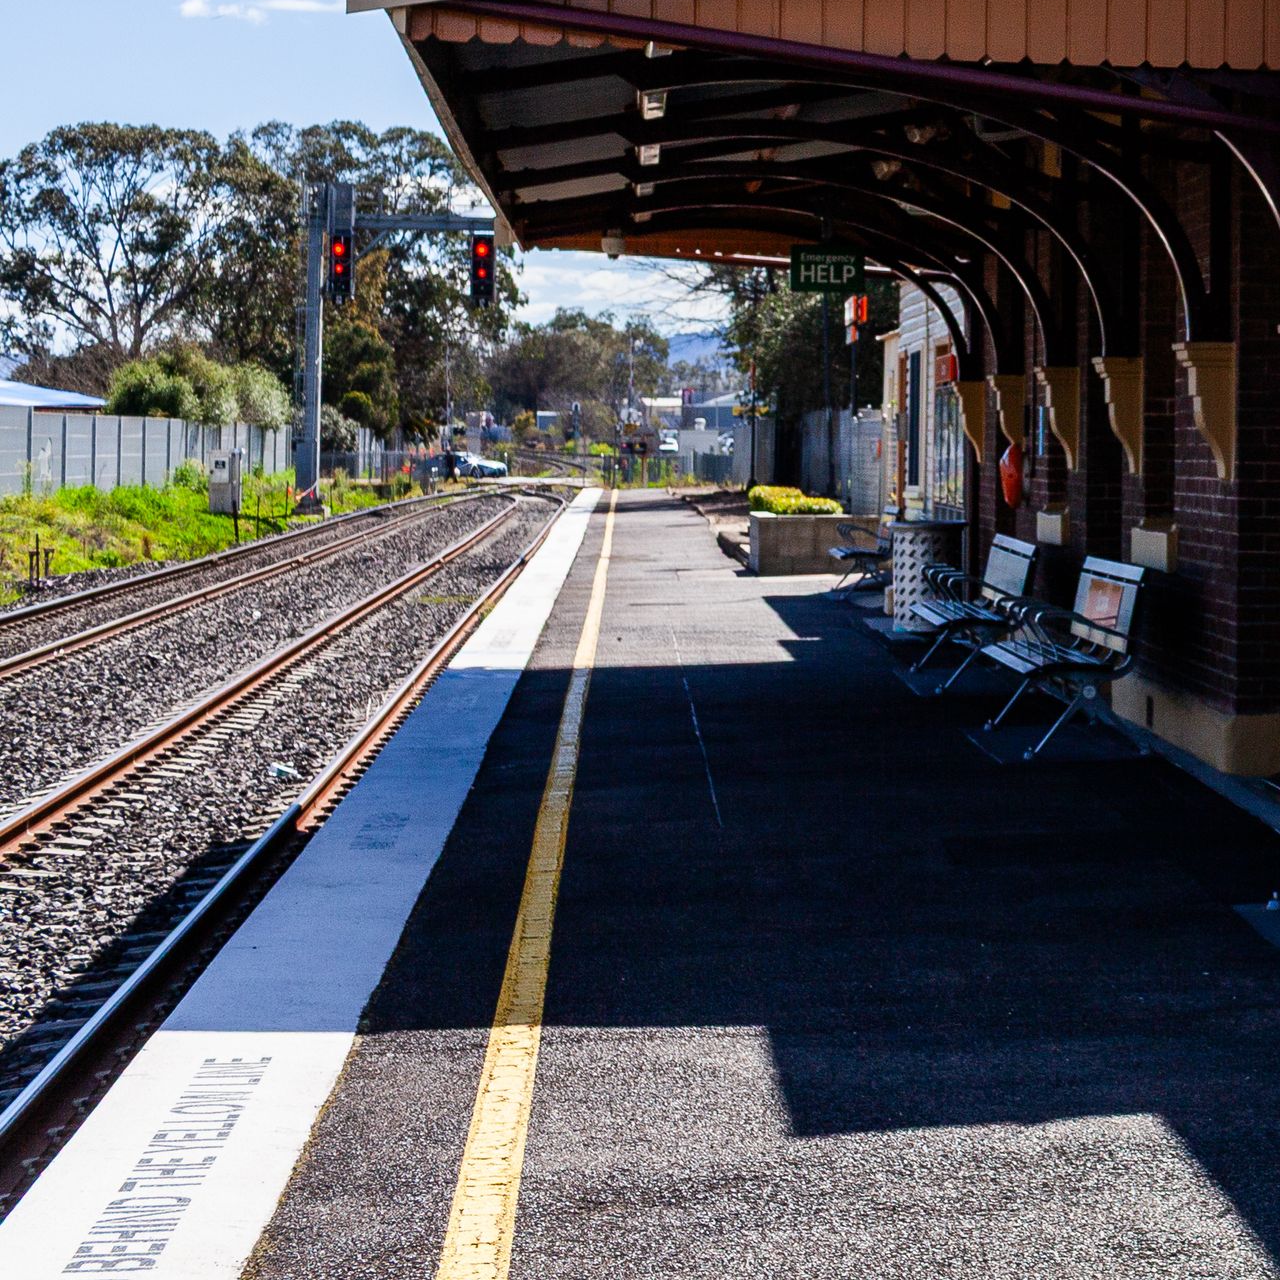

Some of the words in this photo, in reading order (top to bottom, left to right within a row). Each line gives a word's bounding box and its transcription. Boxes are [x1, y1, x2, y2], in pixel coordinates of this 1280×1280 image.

[800, 252, 856, 265] Emergency
[800, 264, 856, 283] HELP
[188, 1057, 273, 1087] LINE
[142, 1091, 254, 1155] YELLOW
[118, 1156, 217, 1193] THE
[61, 1196, 192, 1273] BEHIND
